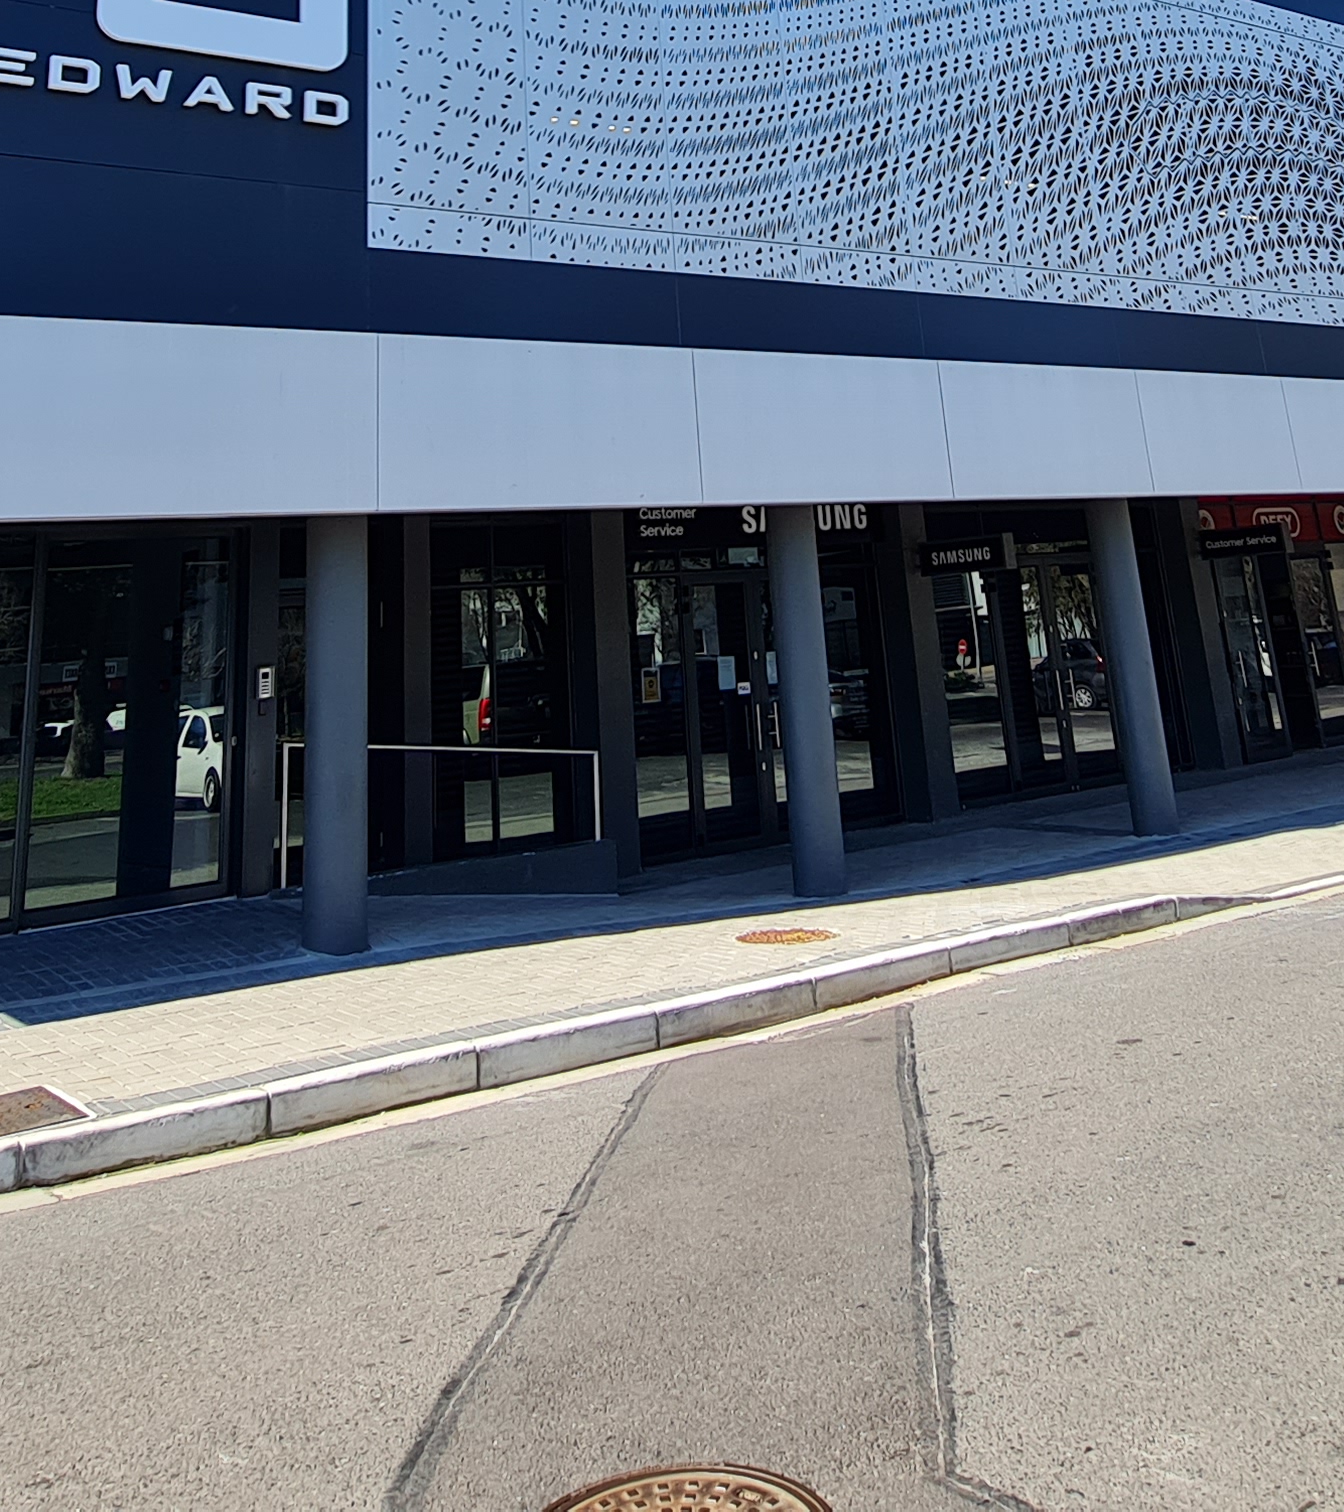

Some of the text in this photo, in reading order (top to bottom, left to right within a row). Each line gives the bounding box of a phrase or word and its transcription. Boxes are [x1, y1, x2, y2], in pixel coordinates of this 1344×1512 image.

[639, 507, 696, 520] Customer
[640, 525, 684, 537] Service
[1206, 535, 1277, 549] Customer Service
[931, 546, 991, 566] SAMSUNG
